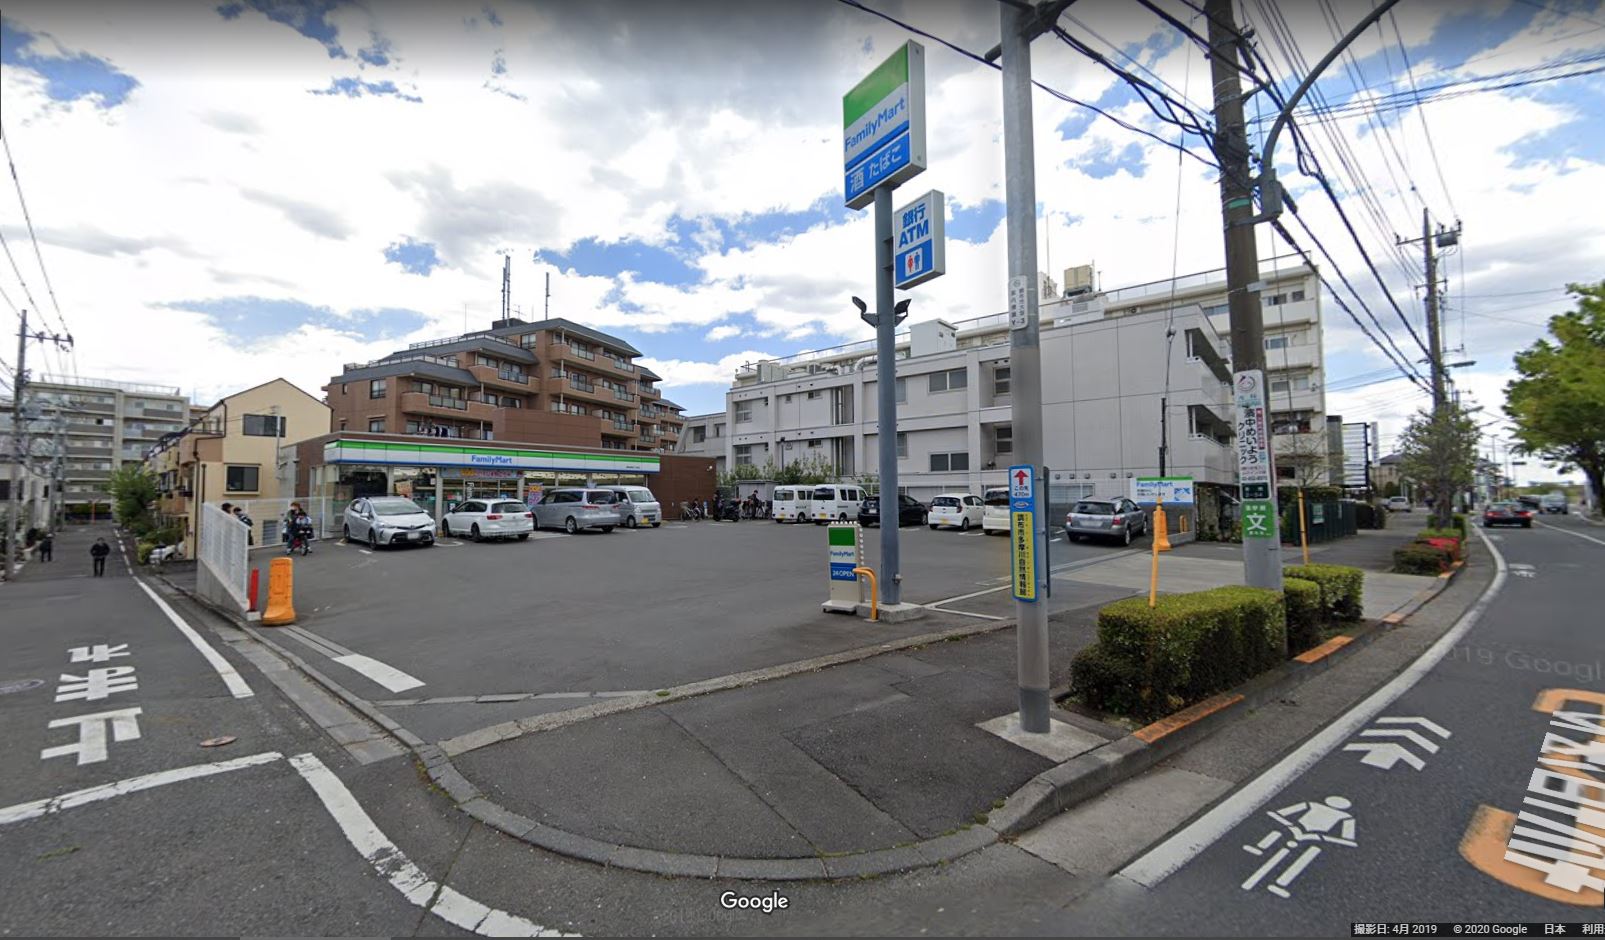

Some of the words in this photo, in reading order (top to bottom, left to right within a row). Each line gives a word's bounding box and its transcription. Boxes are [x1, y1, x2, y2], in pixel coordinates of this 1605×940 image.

[845, 97, 905, 152] FamilyMart
[850, 166, 865, 193] 酒
[868, 145, 902, 179] たばこ
[902, 203, 926, 230] 銀行
[898, 219, 929, 249] ATM
[1238, 422, 1247, 465] クリニック
[471, 455, 512, 466] FamilyMart
[1246, 512, 1267, 531] 文
